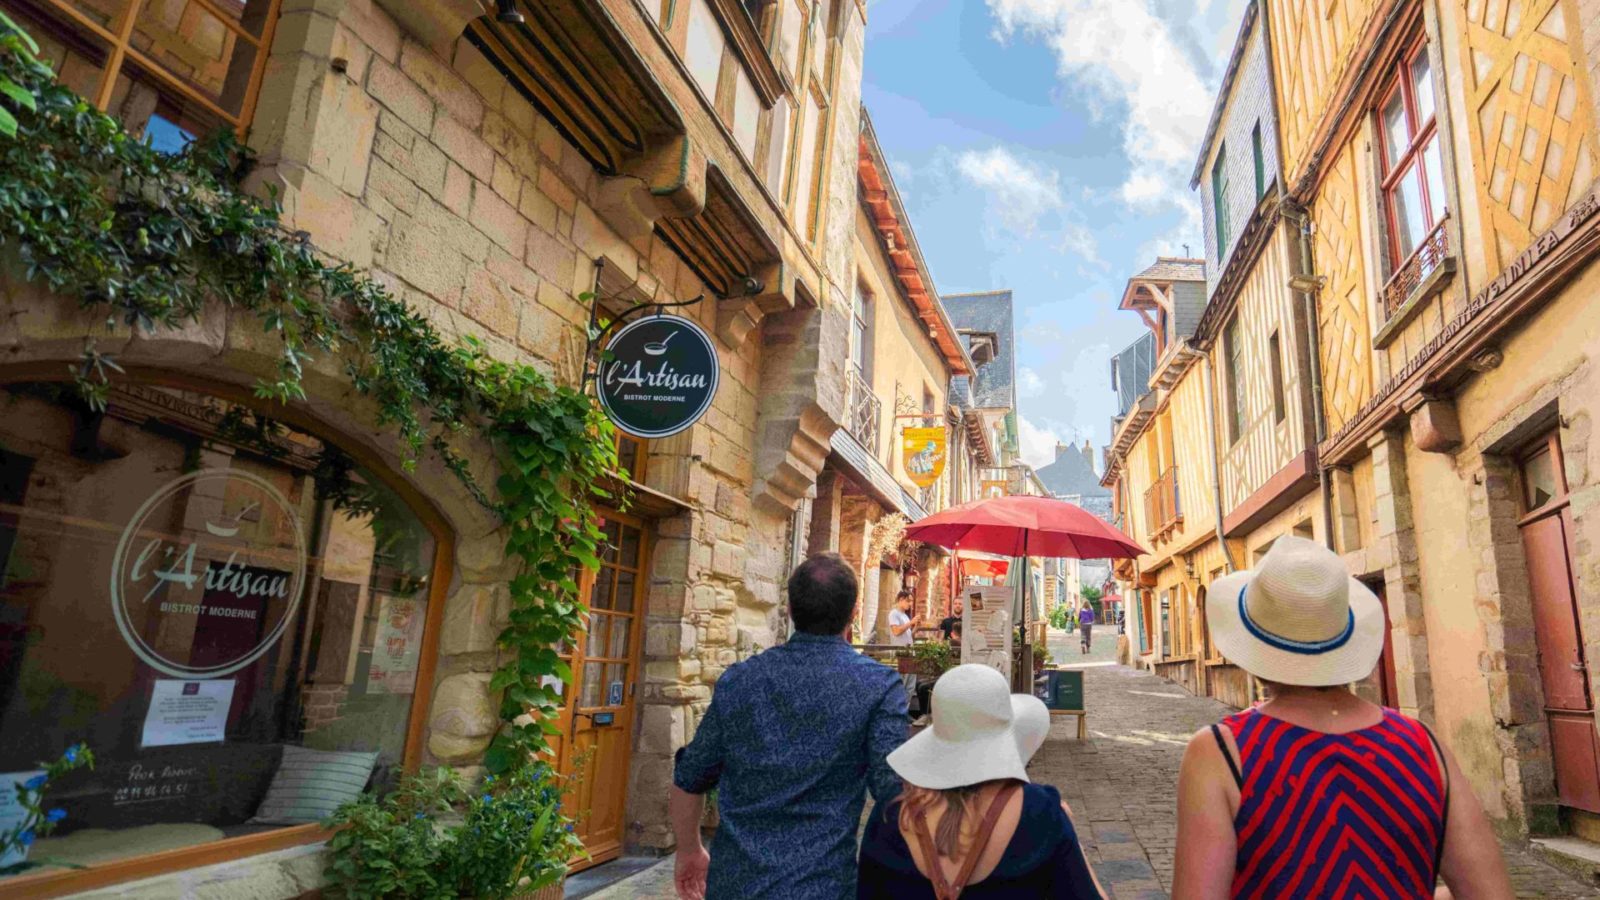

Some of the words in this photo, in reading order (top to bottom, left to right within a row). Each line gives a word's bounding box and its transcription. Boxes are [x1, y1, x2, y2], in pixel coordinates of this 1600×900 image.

[1399, 362, 1411, 383] ET
[1415, 281, 1500, 368] HABITANTIBVS
[1510, 256, 1527, 283] IN
[1536, 230, 1560, 256] EA
[606, 360, 706, 396] l'Artisan
[623, 394, 652, 402] BISTROT
[652, 395, 686, 403] MODERNE
[130, 538, 290, 602] l'Artisan
[160, 602, 207, 617] BISTROT
[208, 606, 257, 620] MODERNE
